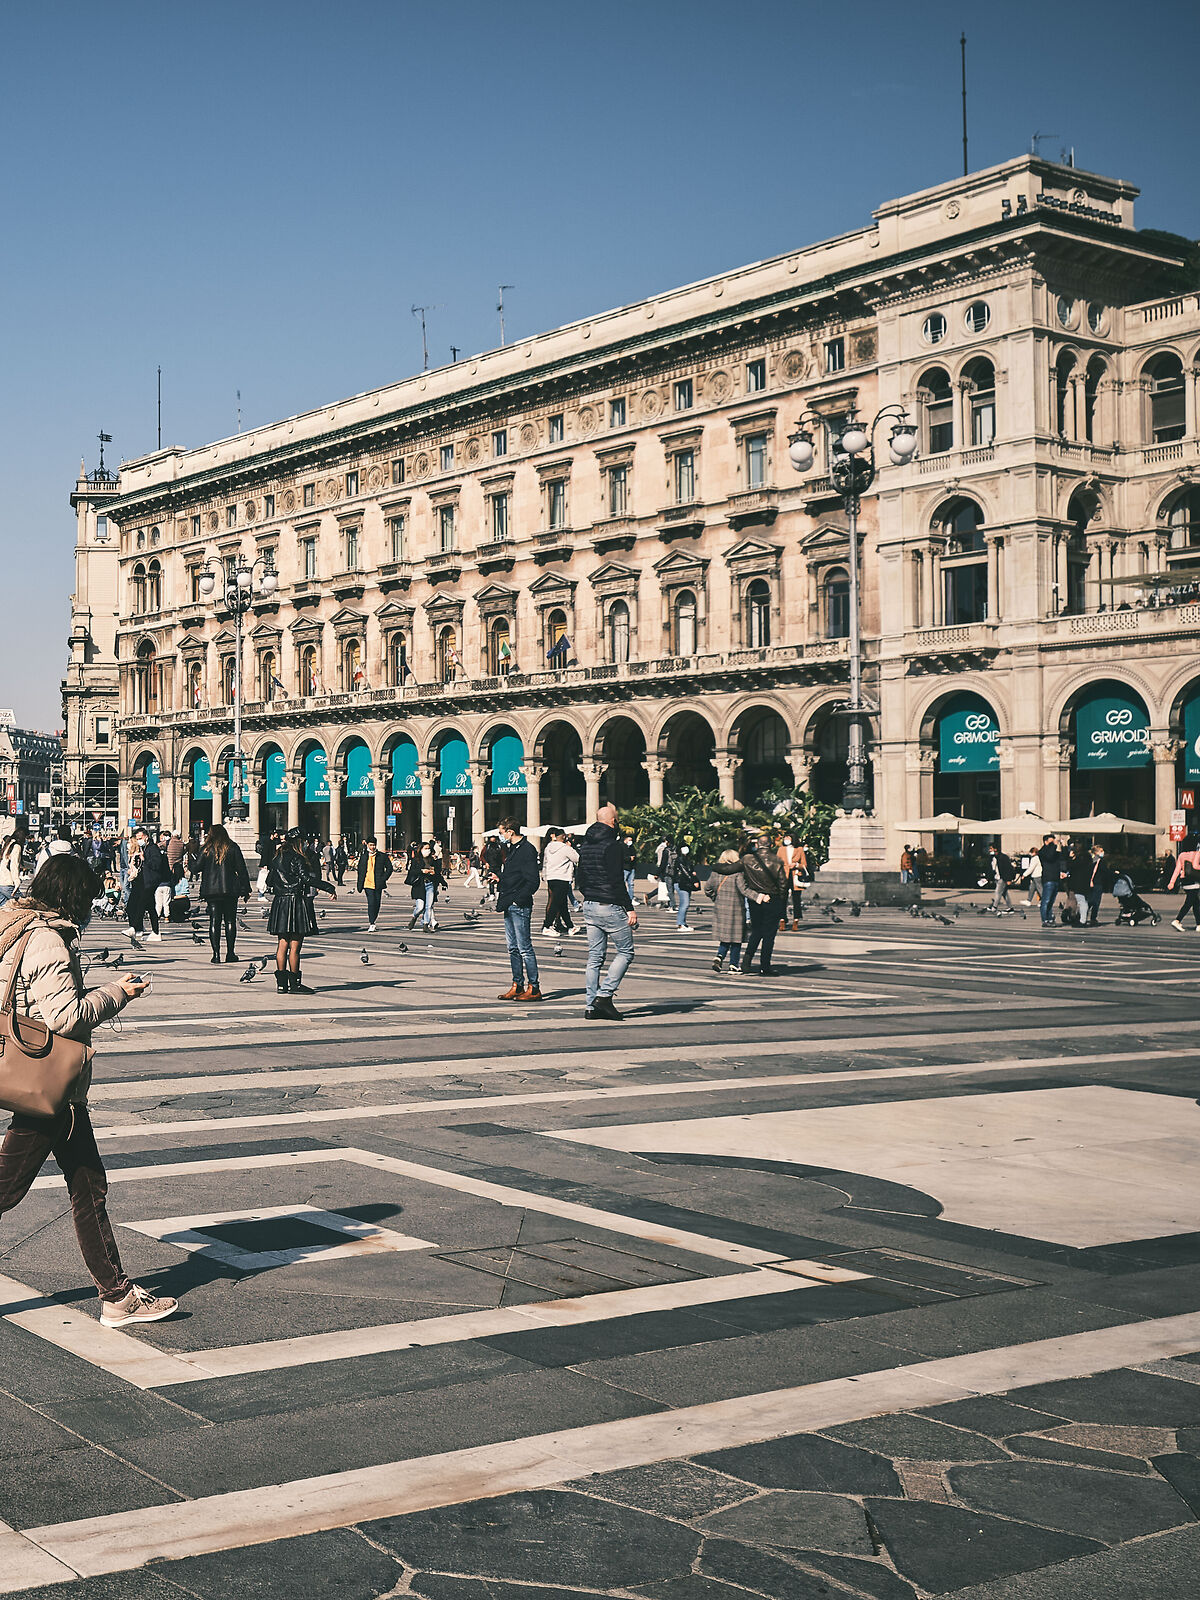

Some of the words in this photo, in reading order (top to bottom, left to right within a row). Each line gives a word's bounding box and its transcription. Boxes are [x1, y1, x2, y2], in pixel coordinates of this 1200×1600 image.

[953, 730, 1000, 744] GRIMOLD
[1091, 728, 1150, 744] GRIMOLDI
[1181, 792, 1193, 806] M
